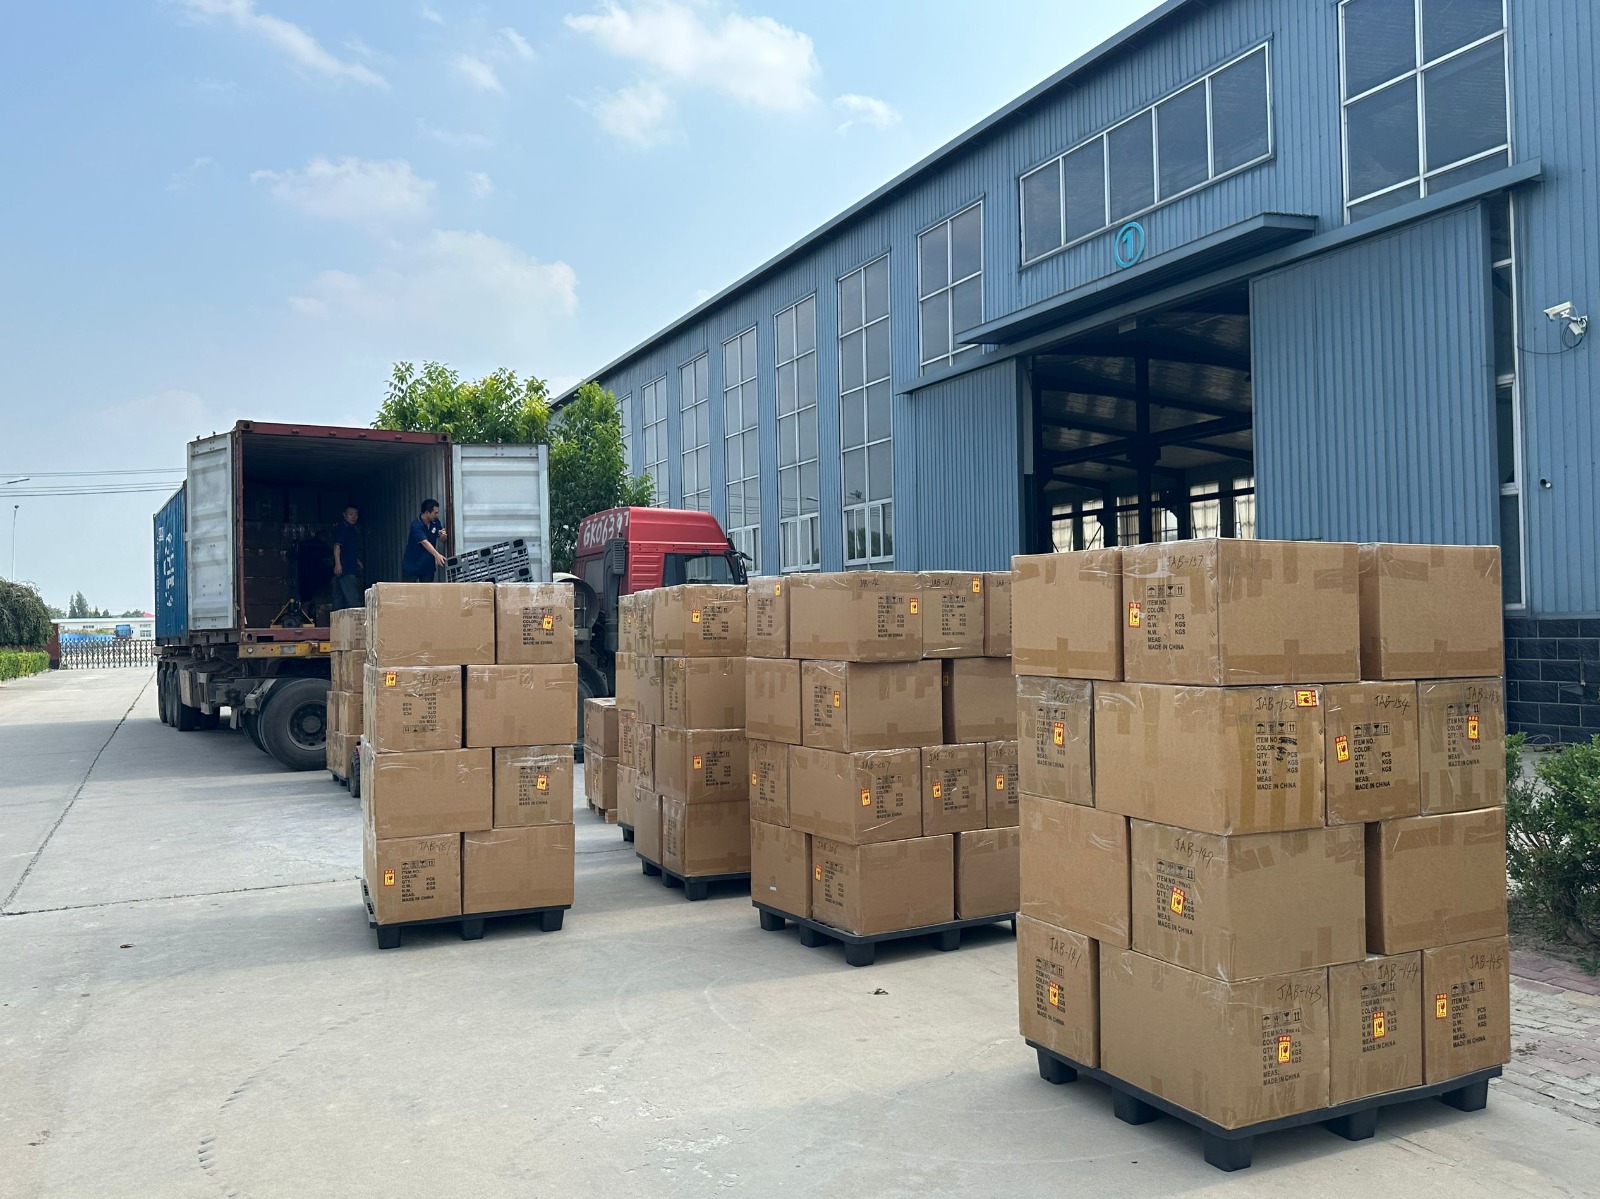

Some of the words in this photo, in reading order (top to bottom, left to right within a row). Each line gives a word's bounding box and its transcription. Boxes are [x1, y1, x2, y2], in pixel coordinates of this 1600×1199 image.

[1157, 875, 1168, 883] ITEM
[1158, 920, 1171, 929] MADE
[1178, 925, 1193, 935] CHINA
[1053, 1016, 1064, 1025] CHINA
[1263, 1030, 1275, 1038] ITEM
[1382, 1040, 1395, 1048] CHINA
[1285, 1072, 1300, 1081] CHINA
